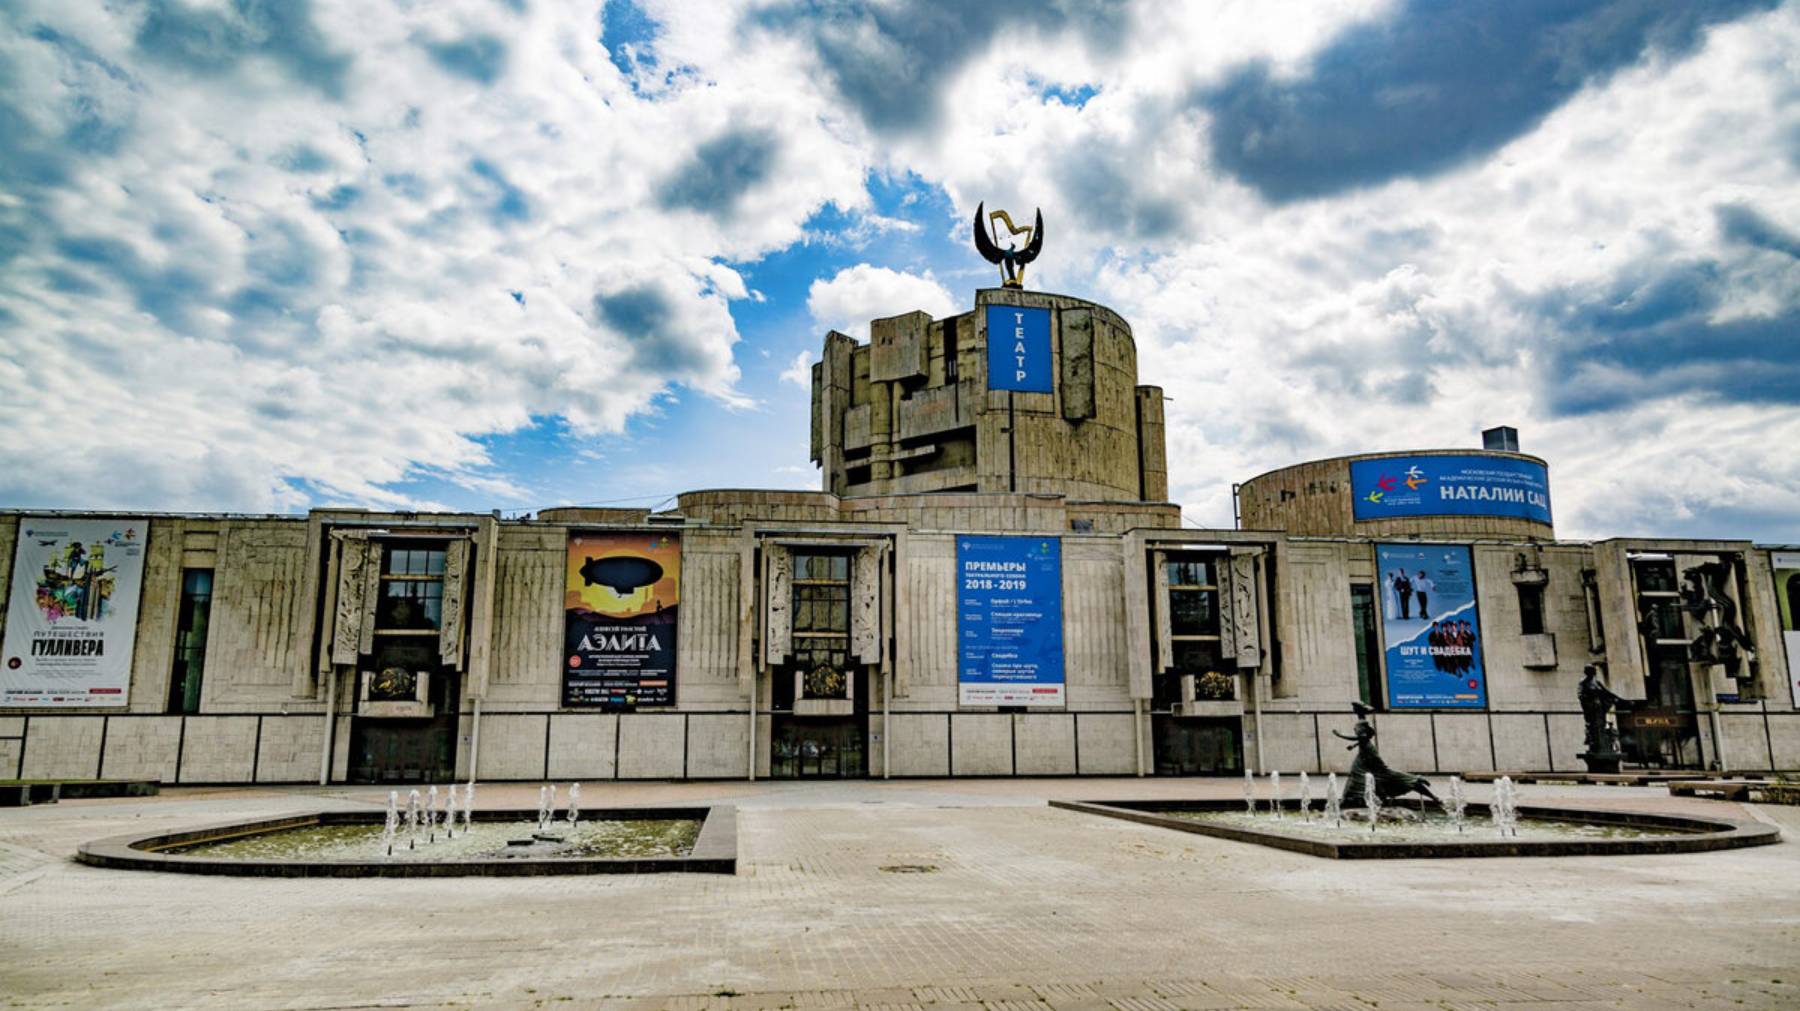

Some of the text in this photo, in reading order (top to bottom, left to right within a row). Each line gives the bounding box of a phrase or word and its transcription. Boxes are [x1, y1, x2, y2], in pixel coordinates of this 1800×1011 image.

[1014, 312, 1026, 382] ТЕАТР
[1440, 485, 1524, 503] НАТАЛИИ
[965, 561, 1026, 571] ПРЕМЬЕРЫ
[33, 630, 104, 638] ПУТЕШЕСТВИЯ
[577, 633, 662, 651] АЭЛИТА
[31, 639, 104, 656] ГУЛЛИВЕРА
[1400, 646, 1472, 656] ШУТ И СВАДЕБКА
